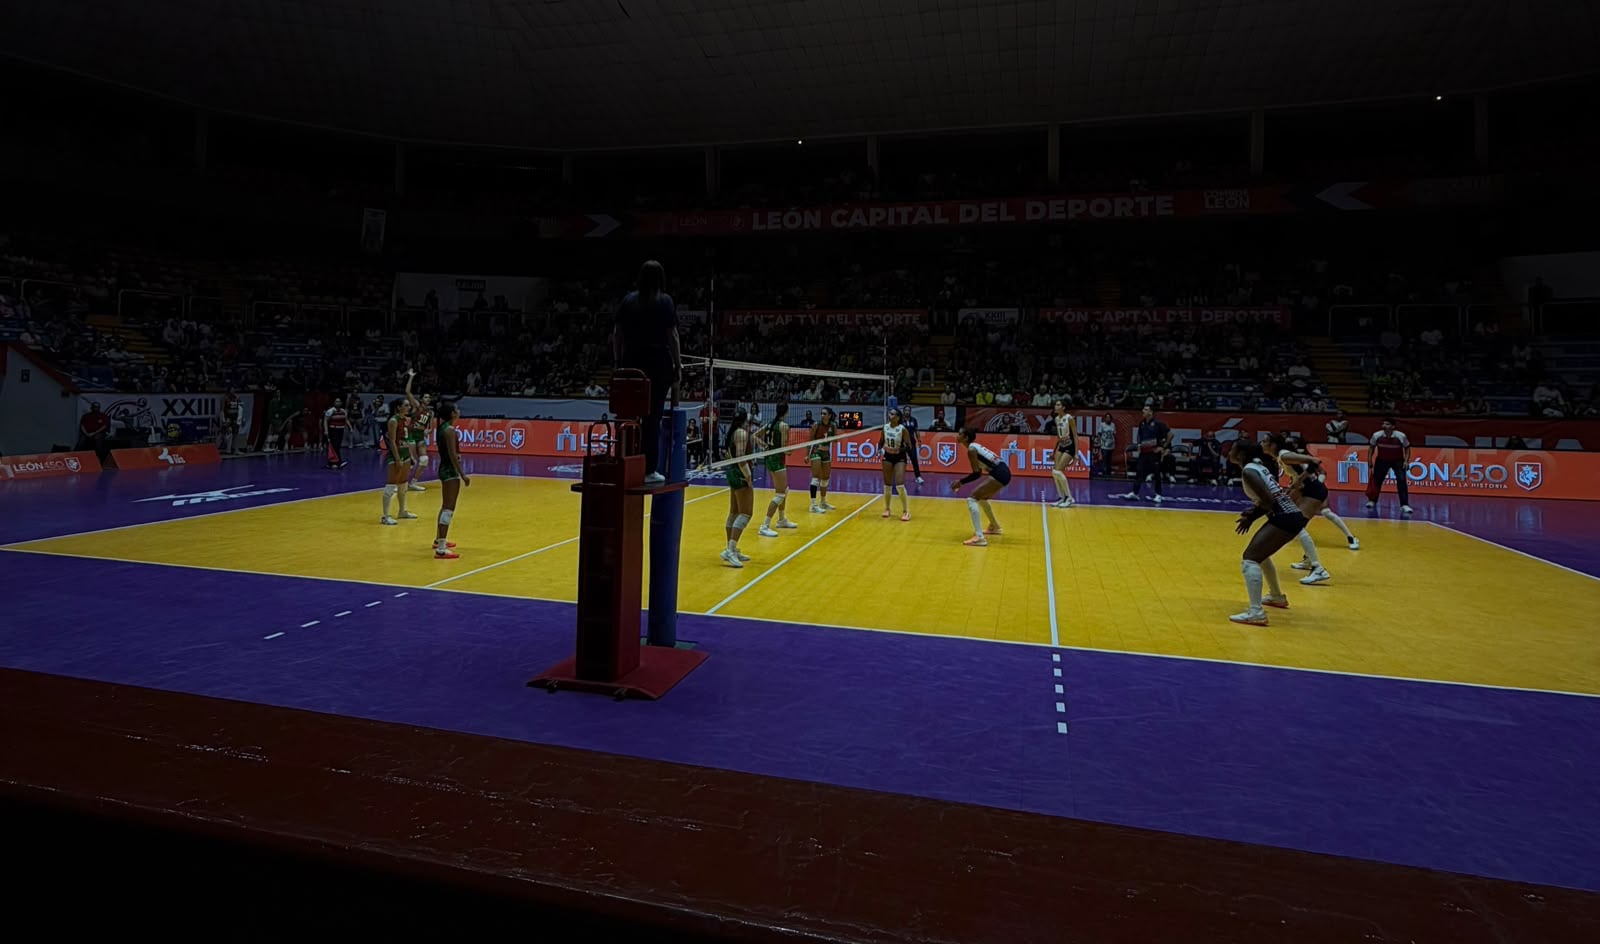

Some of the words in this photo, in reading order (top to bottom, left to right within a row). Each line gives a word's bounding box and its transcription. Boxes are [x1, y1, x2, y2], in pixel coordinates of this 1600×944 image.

[752, 207, 821, 231] LEÓN
[831, 204, 950, 228] CAPITAL
[960, 202, 1016, 224] DEL
[1025, 196, 1175, 221] DEPORTE
[161, 399, 216, 416] XXIII
[433, 425, 507, 444] ÓN450
[1031, 447, 1091, 467] LEN
[1385, 457, 1509, 484] ÓN450
